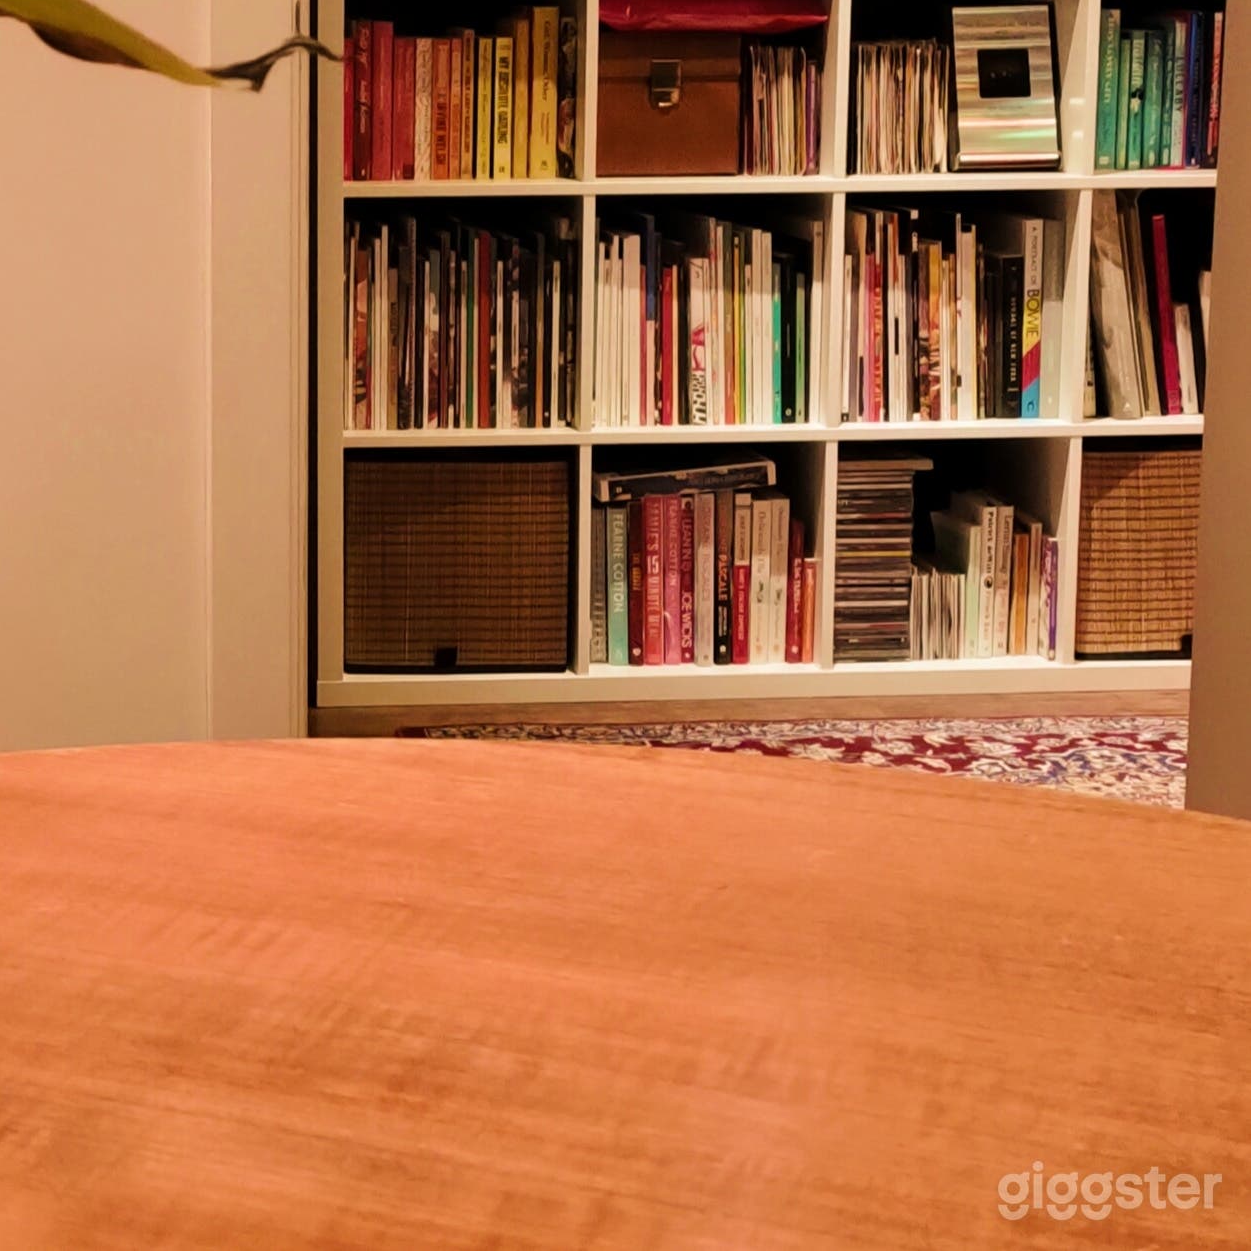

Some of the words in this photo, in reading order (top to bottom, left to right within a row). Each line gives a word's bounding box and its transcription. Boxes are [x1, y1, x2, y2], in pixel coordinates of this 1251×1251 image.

[1026, 288, 1040, 337] BOWIE
[615, 513, 625, 559] FEARNE
[614, 562, 625, 614] COTTON
[682, 590, 693, 611] JOE
[719, 554, 728, 601] PASCALE
[682, 612, 693, 648] WICKS
